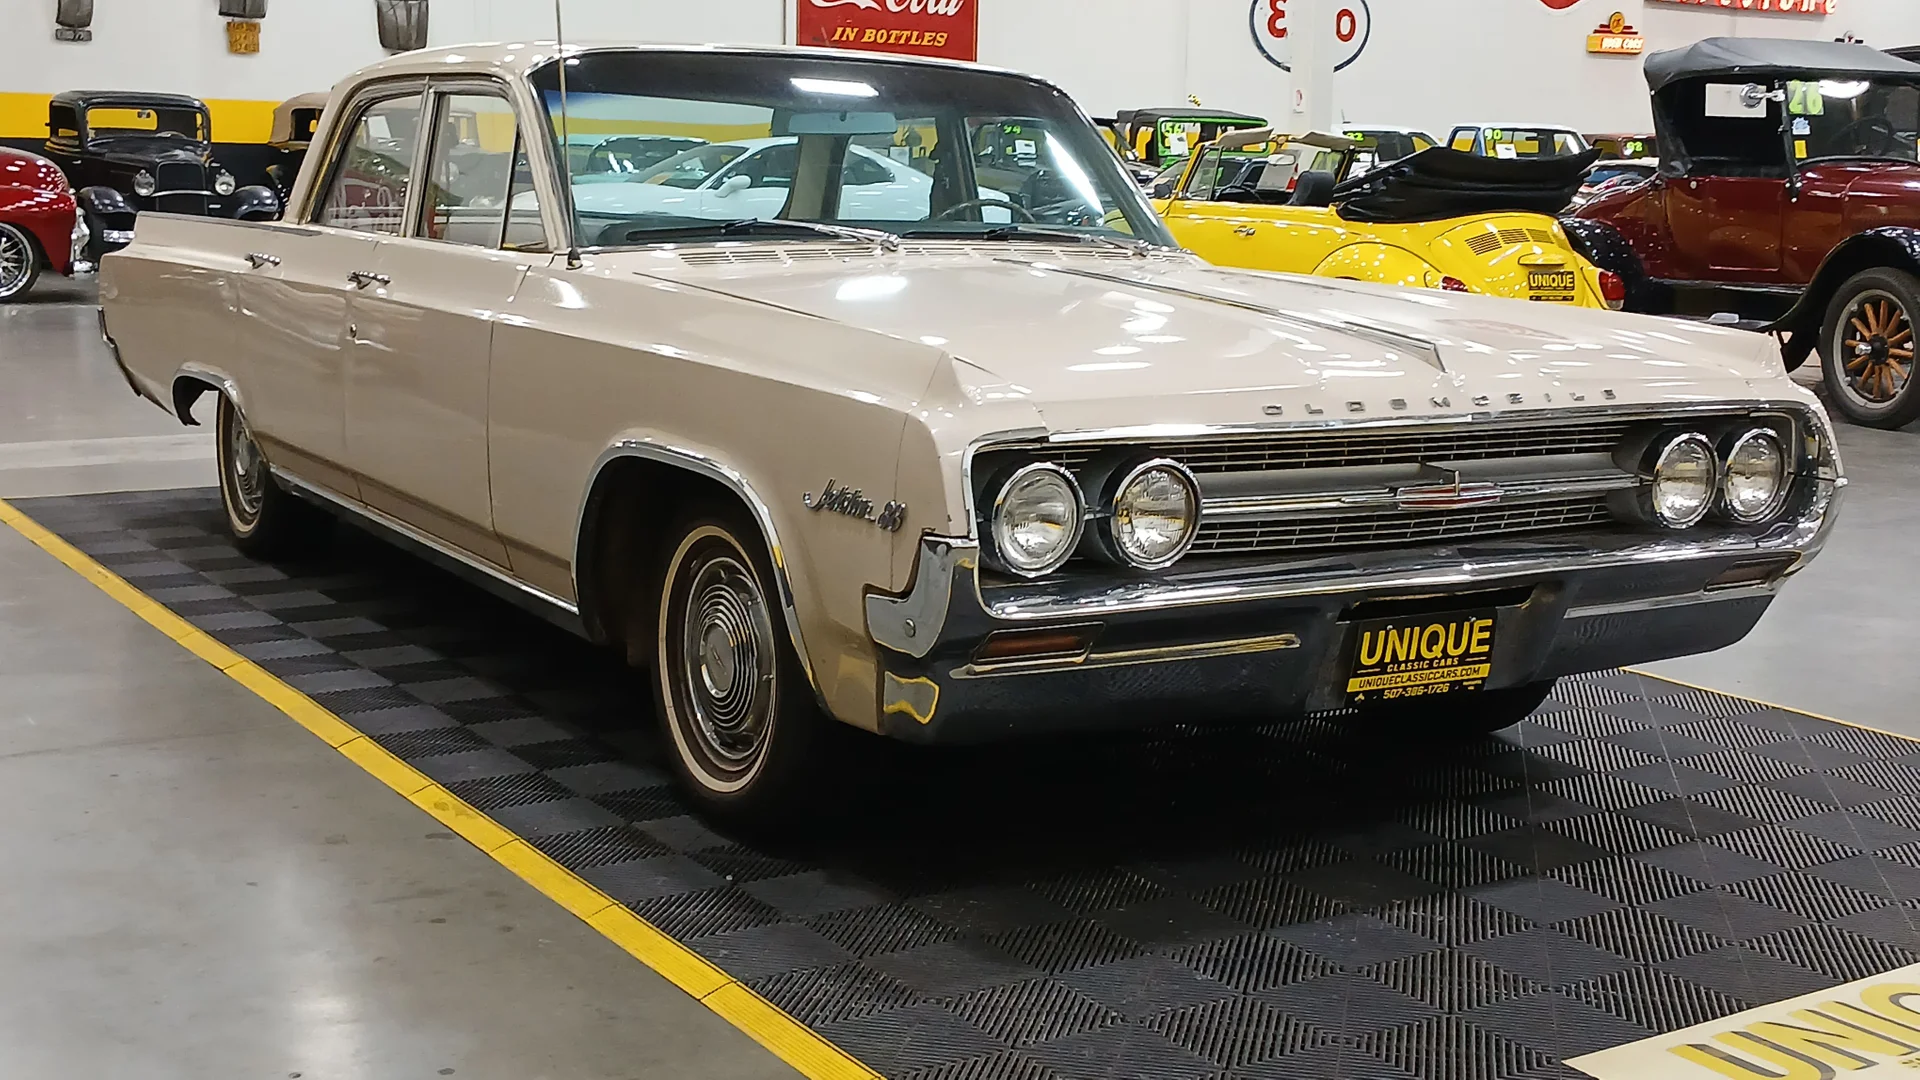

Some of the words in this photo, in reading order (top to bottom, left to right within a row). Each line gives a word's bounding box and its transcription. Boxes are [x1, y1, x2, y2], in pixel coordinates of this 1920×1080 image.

[831, 27, 859, 41] IN
[861, 29, 948, 47] BOTTLES
[1529, 274, 1574, 287] UNIQUE
[1360, 618, 1493, 666] UNIQUE
[1387, 660, 1430, 673] CLASSIC
[1432, 657, 1460, 669] CARS
[1358, 667, 1482, 689] UNIQUECLASSICCARS.COM
